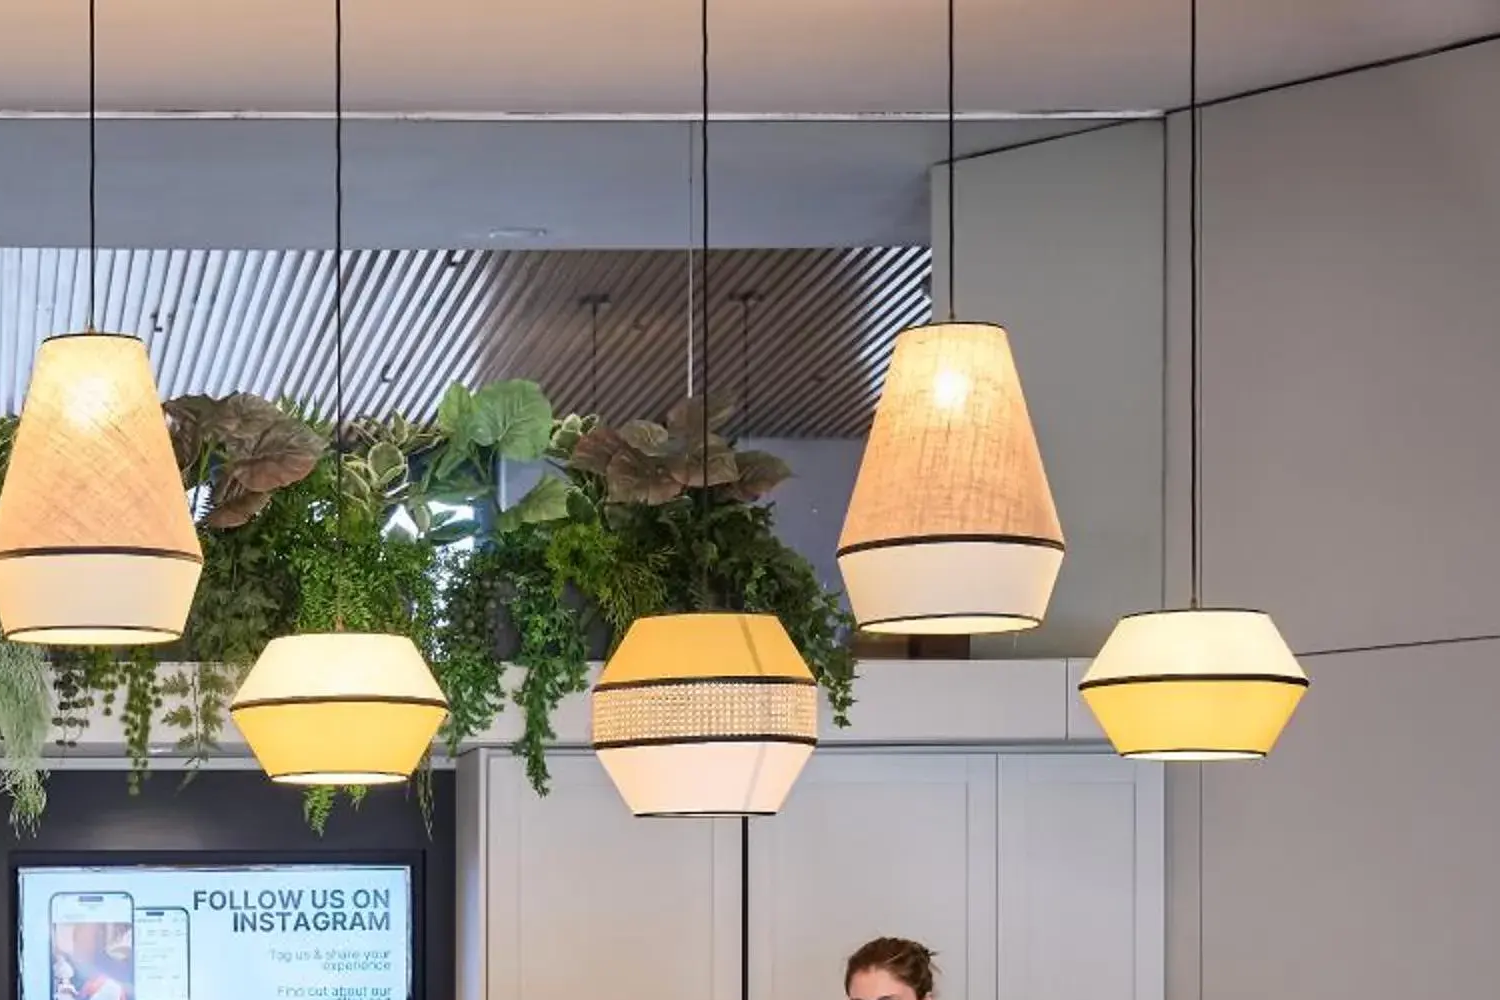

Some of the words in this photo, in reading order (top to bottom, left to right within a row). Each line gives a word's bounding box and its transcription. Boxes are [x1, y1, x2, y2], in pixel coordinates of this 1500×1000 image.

[193, 889, 303, 911] FOLLOW
[311, 889, 345, 910] US
[352, 889, 390, 909] ON
[233, 911, 390, 932] INSTAGRAM
[269, 949, 293, 963] Tag
[363, 950, 390, 961] your
[331, 985, 368, 997] about
